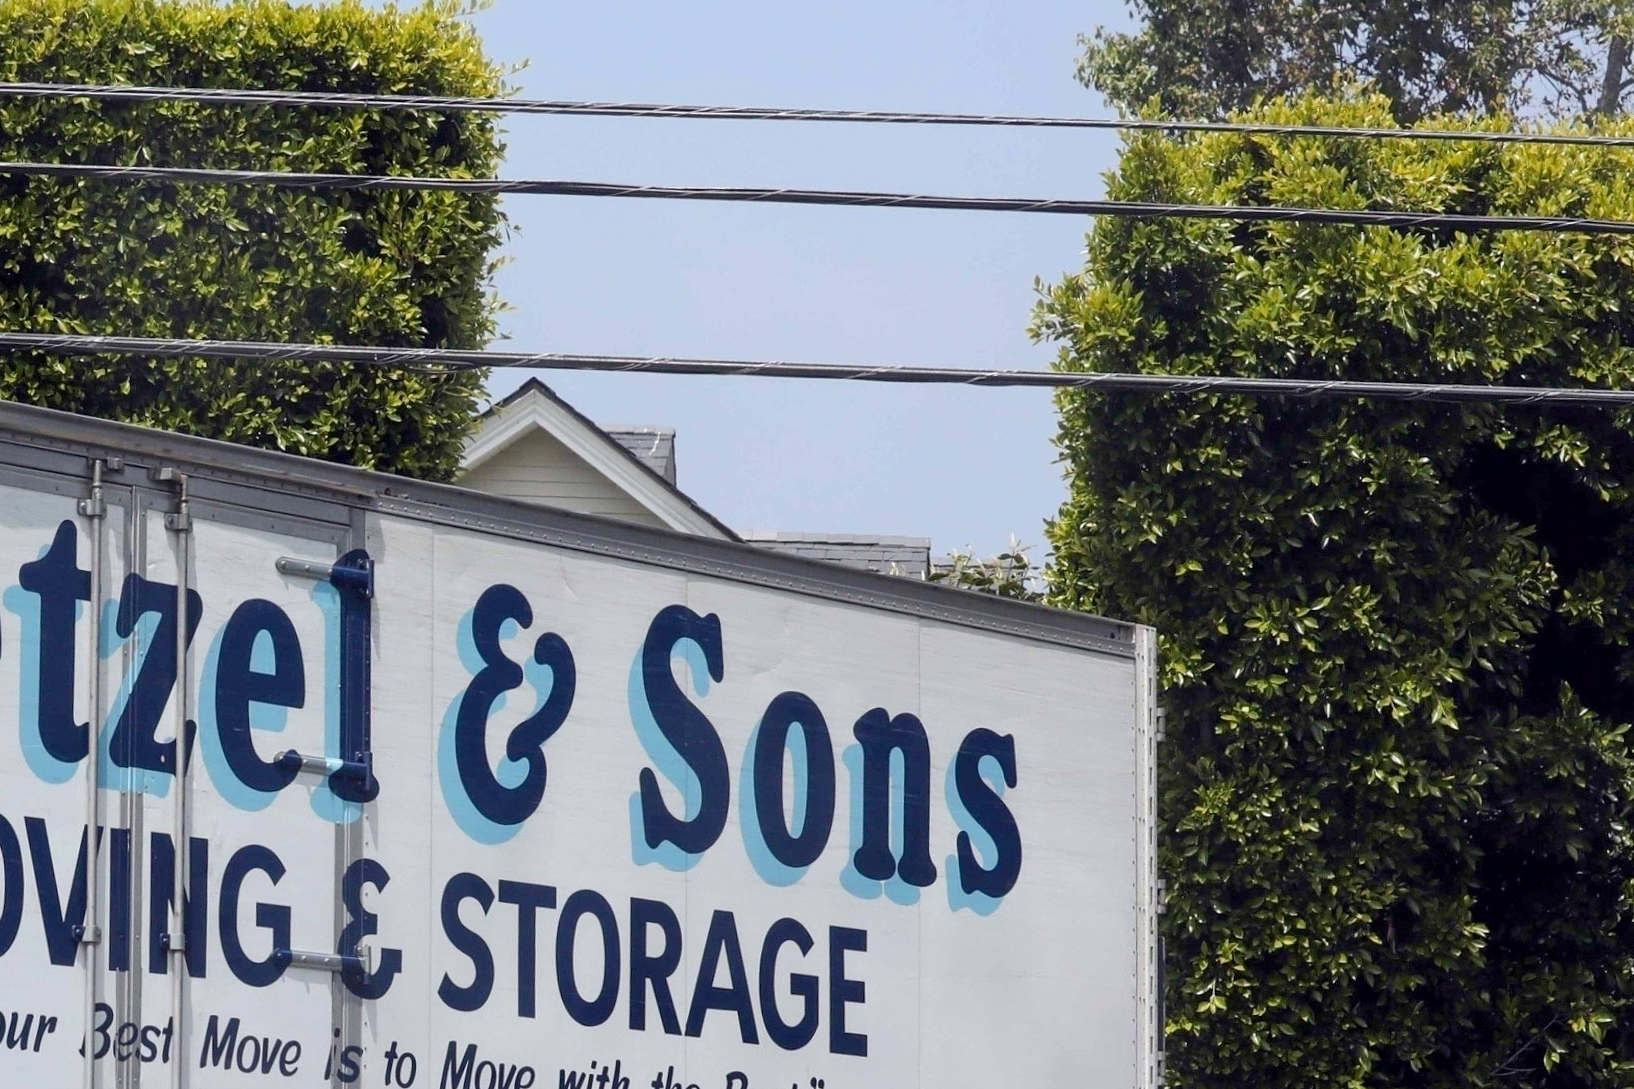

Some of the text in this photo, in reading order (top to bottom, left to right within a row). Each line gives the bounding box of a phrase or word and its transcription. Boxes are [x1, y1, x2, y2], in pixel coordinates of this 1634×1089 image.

[437, 583, 576, 845] &
[628, 604, 1022, 917] Sons
[78, 1002, 174, 1064] Best
[199, 1014, 302, 1078] Move
[323, 1027, 365, 1084] is
[383, 1040, 418, 1089] to
[339, 857, 403, 1001] &
[437, 871, 868, 1058] STORAGE
